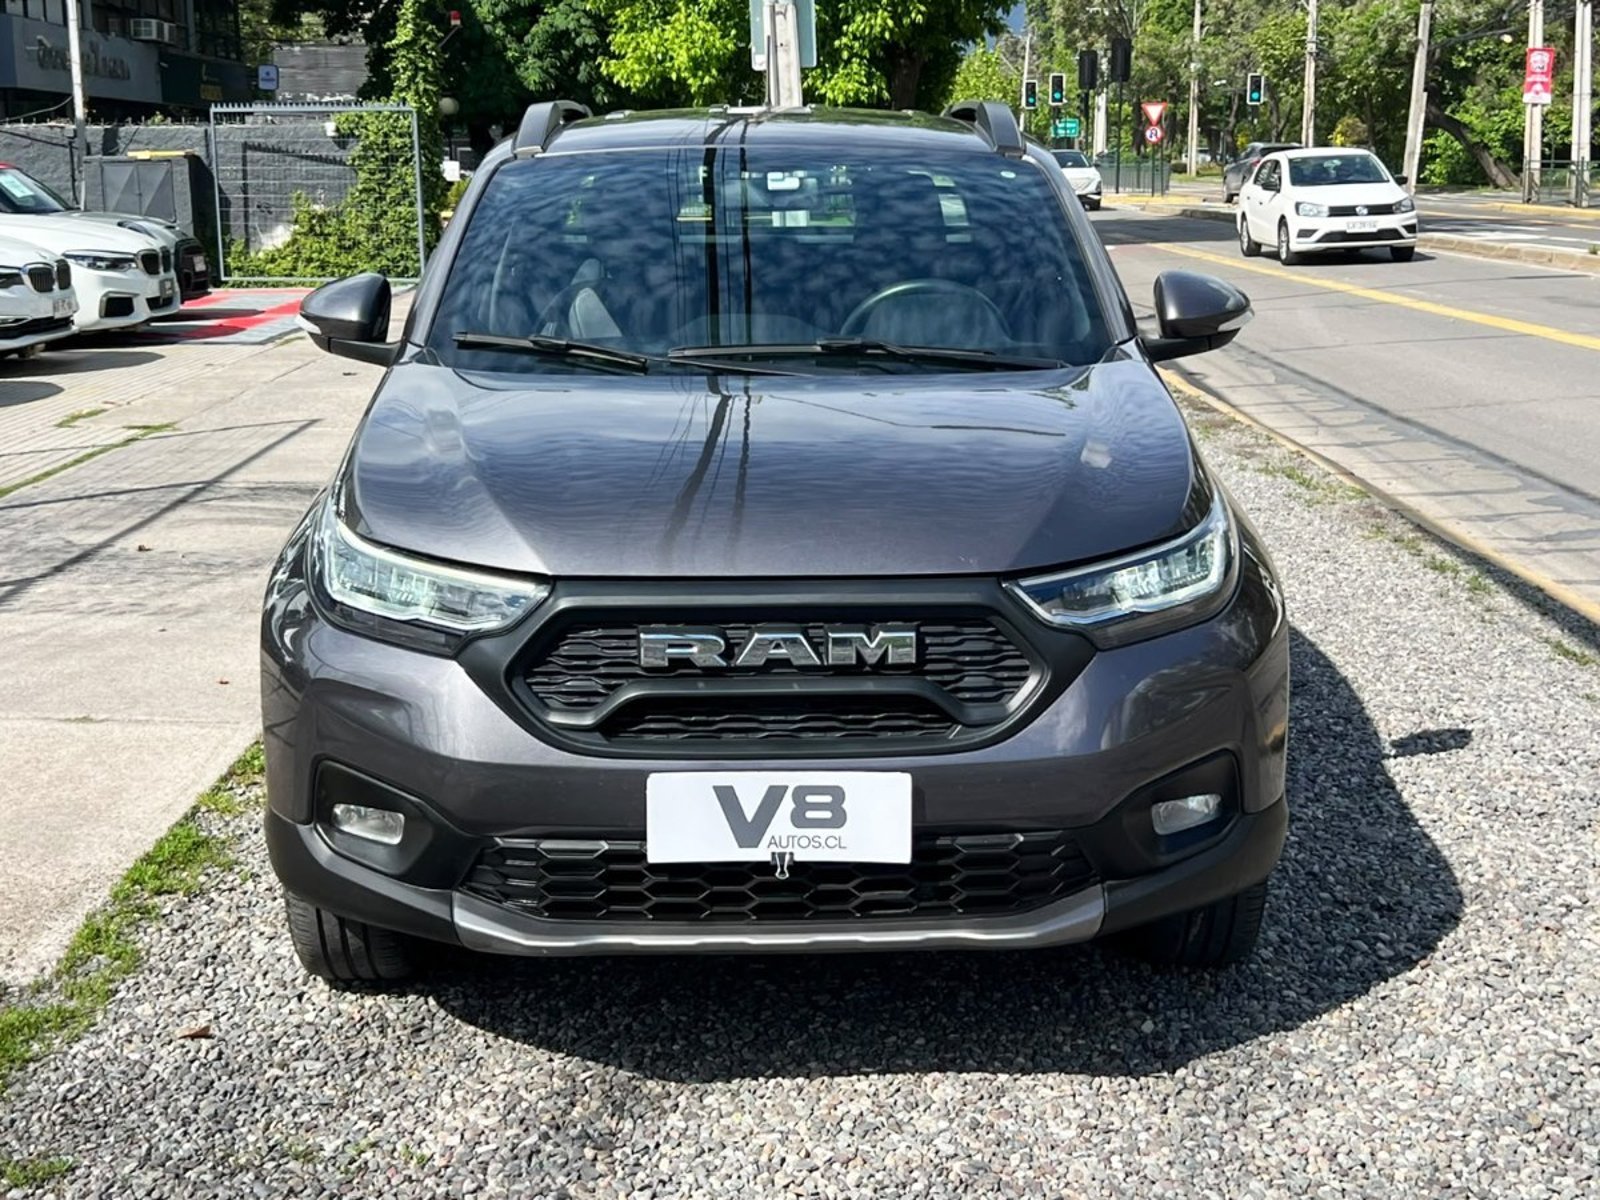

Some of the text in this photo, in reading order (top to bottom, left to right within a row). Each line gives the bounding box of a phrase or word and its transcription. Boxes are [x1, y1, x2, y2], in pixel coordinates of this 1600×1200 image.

[638, 624, 918, 668] RAM
[712, 785, 847, 849] V8
[767, 835, 847, 849] AUTOS.CL
